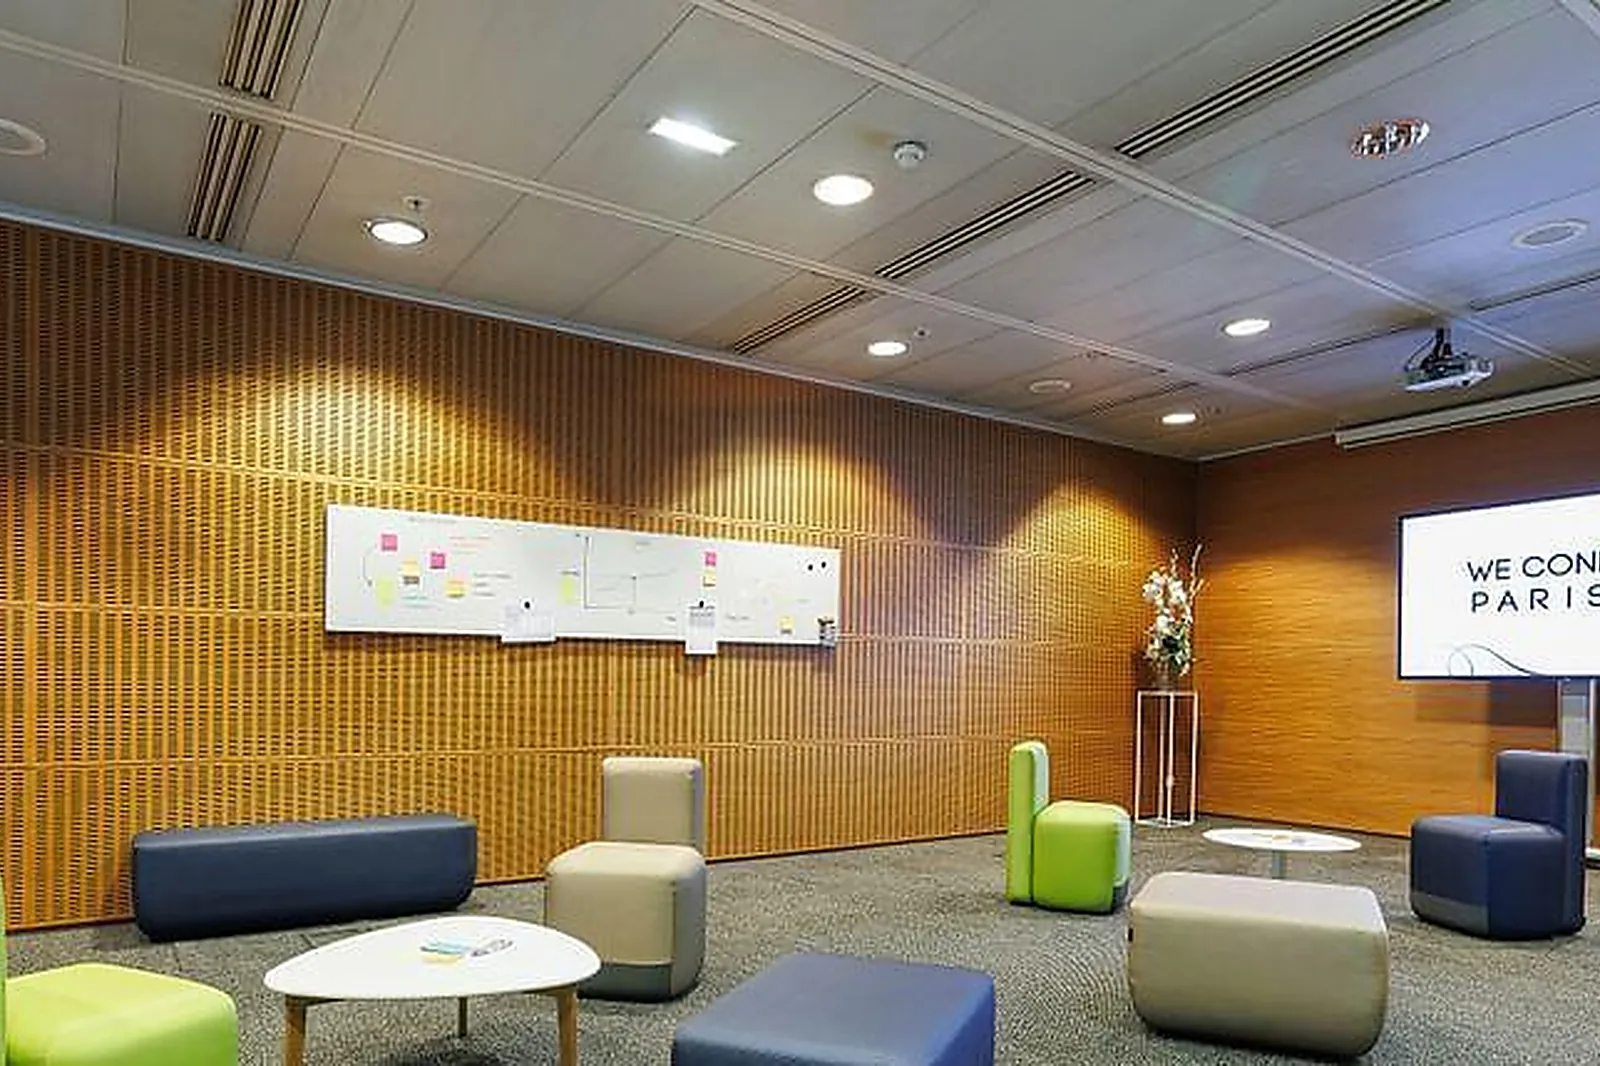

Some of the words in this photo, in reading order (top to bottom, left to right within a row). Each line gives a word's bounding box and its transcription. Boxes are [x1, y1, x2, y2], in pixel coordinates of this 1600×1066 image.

[1467, 558, 1511, 581] WE
[1522, 550, 1600, 578] CON
[1471, 584, 1600, 612] PARIS
